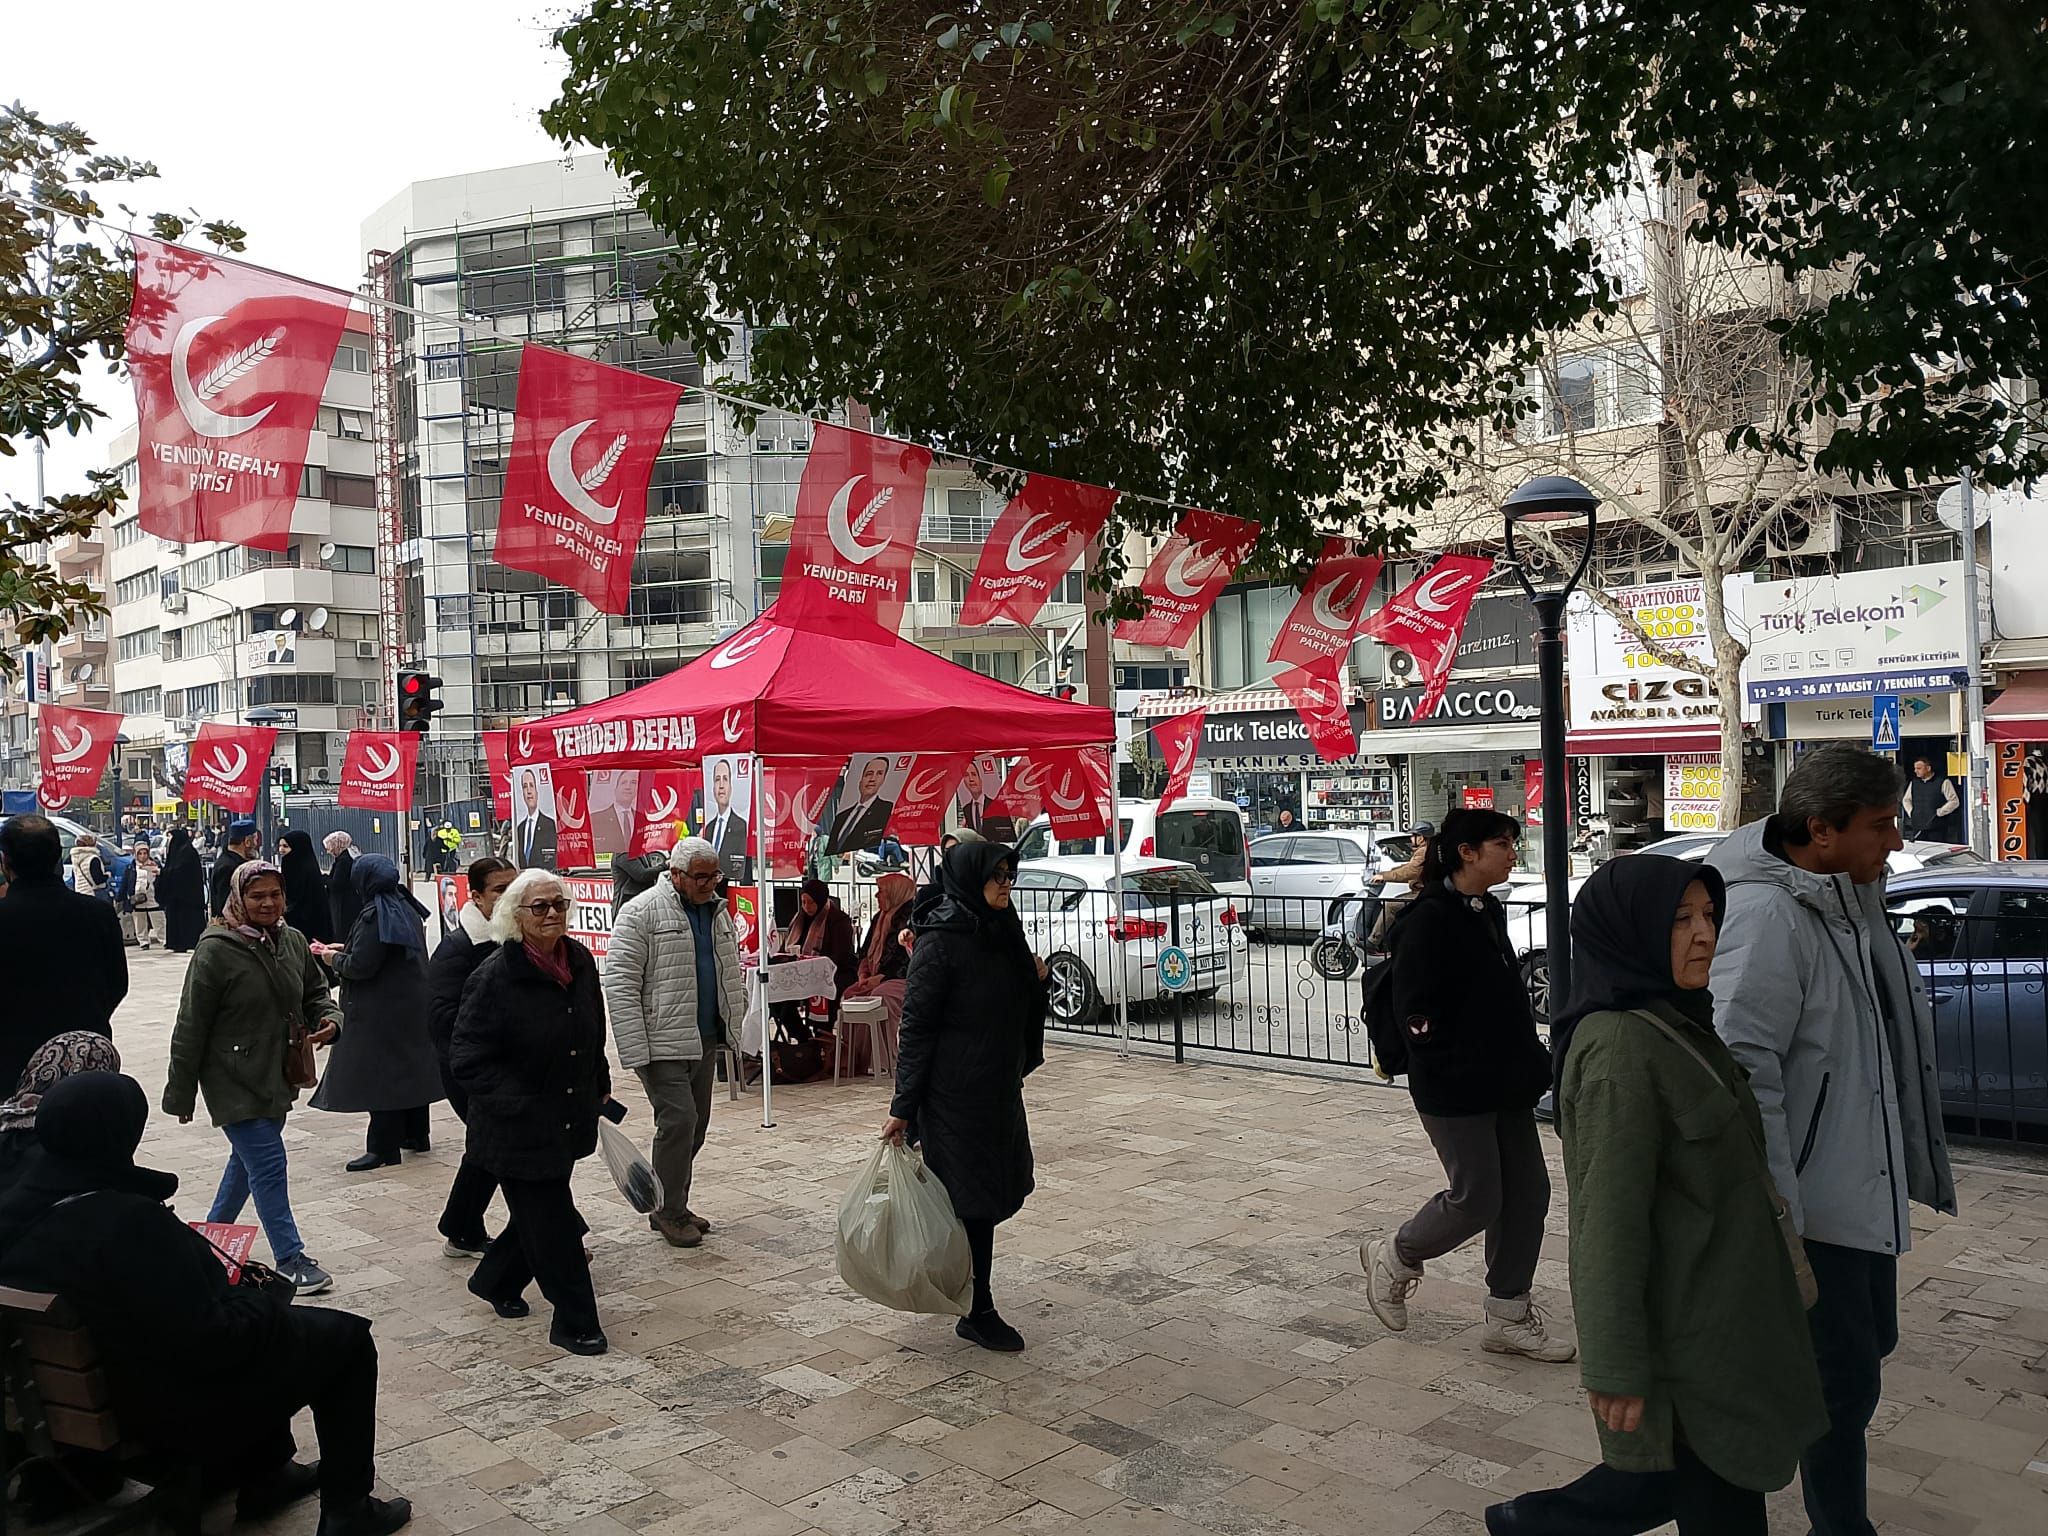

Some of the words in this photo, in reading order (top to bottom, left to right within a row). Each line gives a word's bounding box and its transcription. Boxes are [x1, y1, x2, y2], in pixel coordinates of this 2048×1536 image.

[216, 451, 280, 478] REFAH
[523, 503, 593, 543] YENİDEN
[555, 533, 609, 573] PARTİSİ
[1616, 587, 1701, 609] KAPATIYORUZ
[1149, 608, 1183, 624] PARTİSİ
[1421, 615, 1447, 631] REFAH
[1637, 605, 1694, 623] 500
[1760, 612, 1805, 631] Türk
[1812, 604, 1905, 627] Telekom
[1289, 622, 1330, 641] YENİDEN
[1396, 615, 1428, 634] PARTİSİ
[1299, 637, 1337, 658] PARTİSİ
[1878, 654, 1919, 666] ŞENTÜRK
[1920, 650, 1960, 663] İLETİŞİM
[1754, 687, 1767, 700] 12
[1777, 685, 1791, 698] 24
[1802, 684, 1816, 696] 36
[1819, 683, 1833, 695] AY
[1834, 679, 1873, 693] TAKSİT
[1884, 674, 1925, 690] TEKNİK
[1928, 674, 1954, 686] SER
[1382, 689, 1516, 721] BAACCO
[1666, 707, 1677, 717] &
[1815, 709, 1845, 721] Türk
[552, 717, 628, 758] YENİDEN
[631, 716, 697, 751] REFAH
[1204, 723, 1244, 743] Türk
[1669, 765, 1680, 797] BOTLAR
[1681, 766, 1721, 781] 500
[1577, 757, 1590, 826] BARACCO
[1680, 782, 1721, 799] 800
[1670, 812, 1716, 828] 1000
